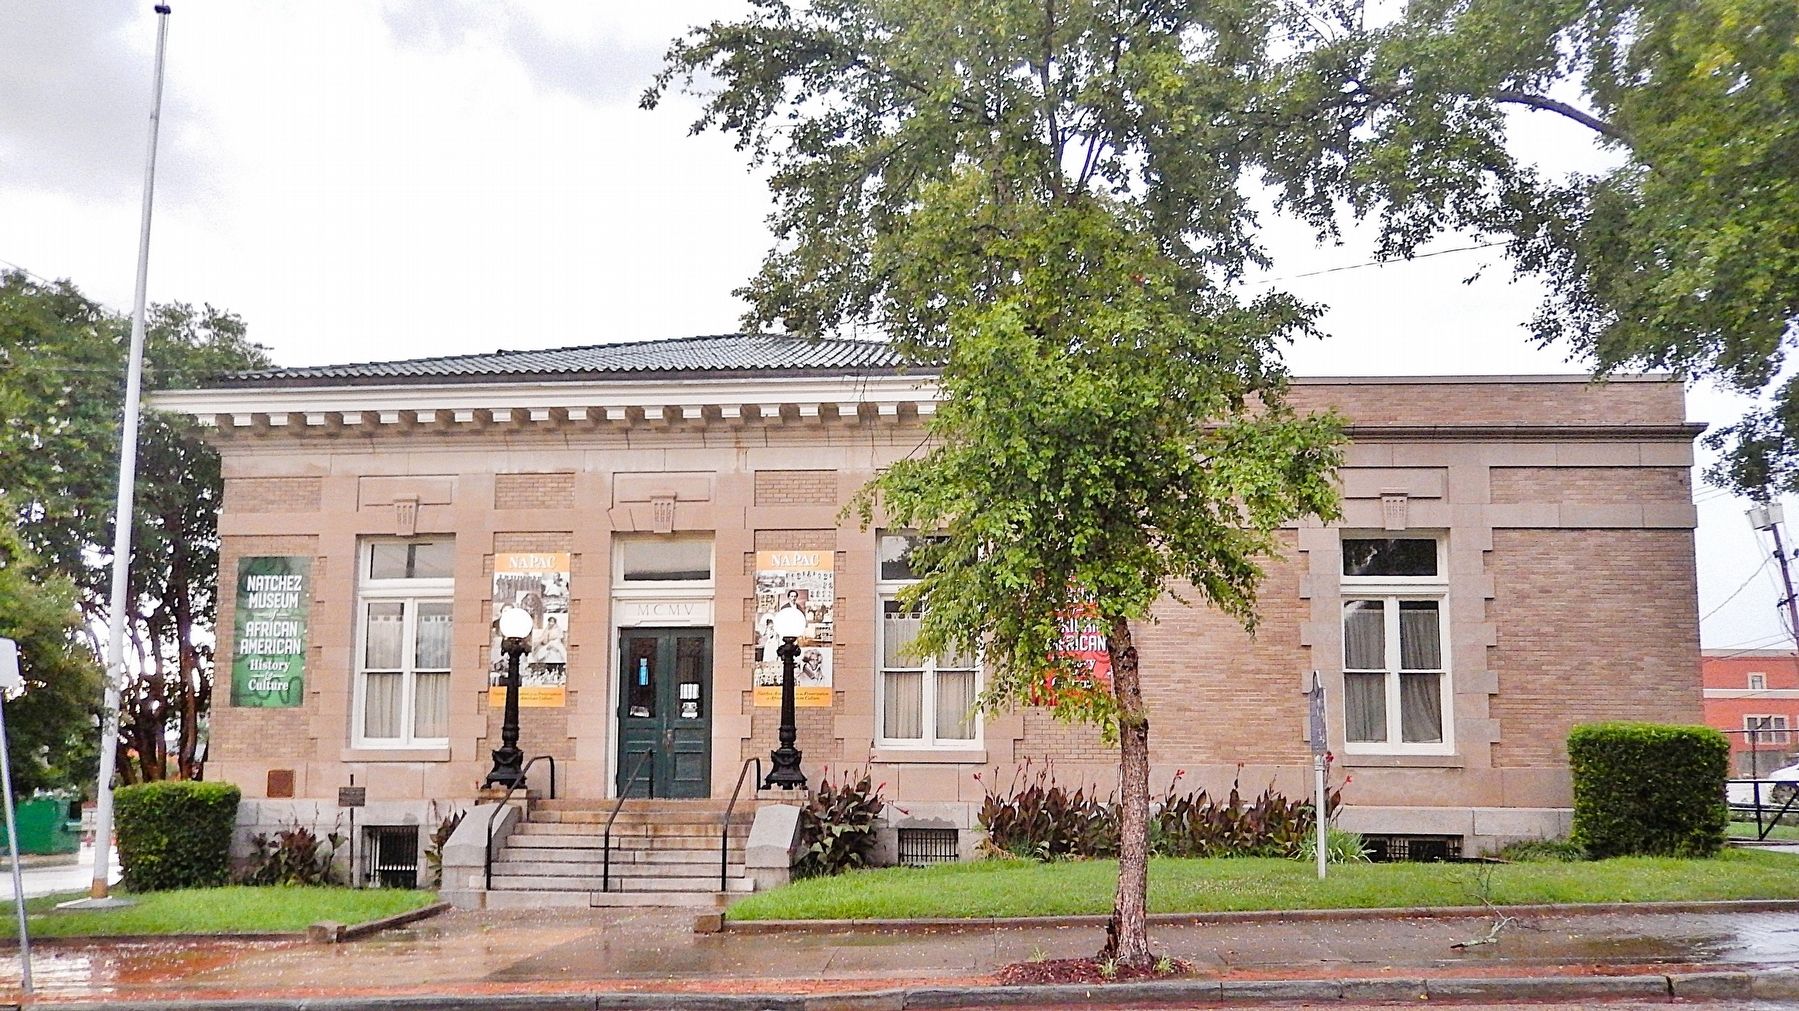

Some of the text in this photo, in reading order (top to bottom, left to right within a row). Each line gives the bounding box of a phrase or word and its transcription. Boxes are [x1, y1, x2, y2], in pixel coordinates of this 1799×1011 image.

[246, 575, 302, 592] NATCHEZ
[248, 592, 299, 609] MUSEUM
[268, 608, 279, 620] of
[637, 603, 694, 616] MCMV
[245, 621, 298, 637] AFRICAN
[239, 638, 302, 655] AMERICAN
[249, 659, 290, 673] History
[248, 679, 289, 691] Culture
